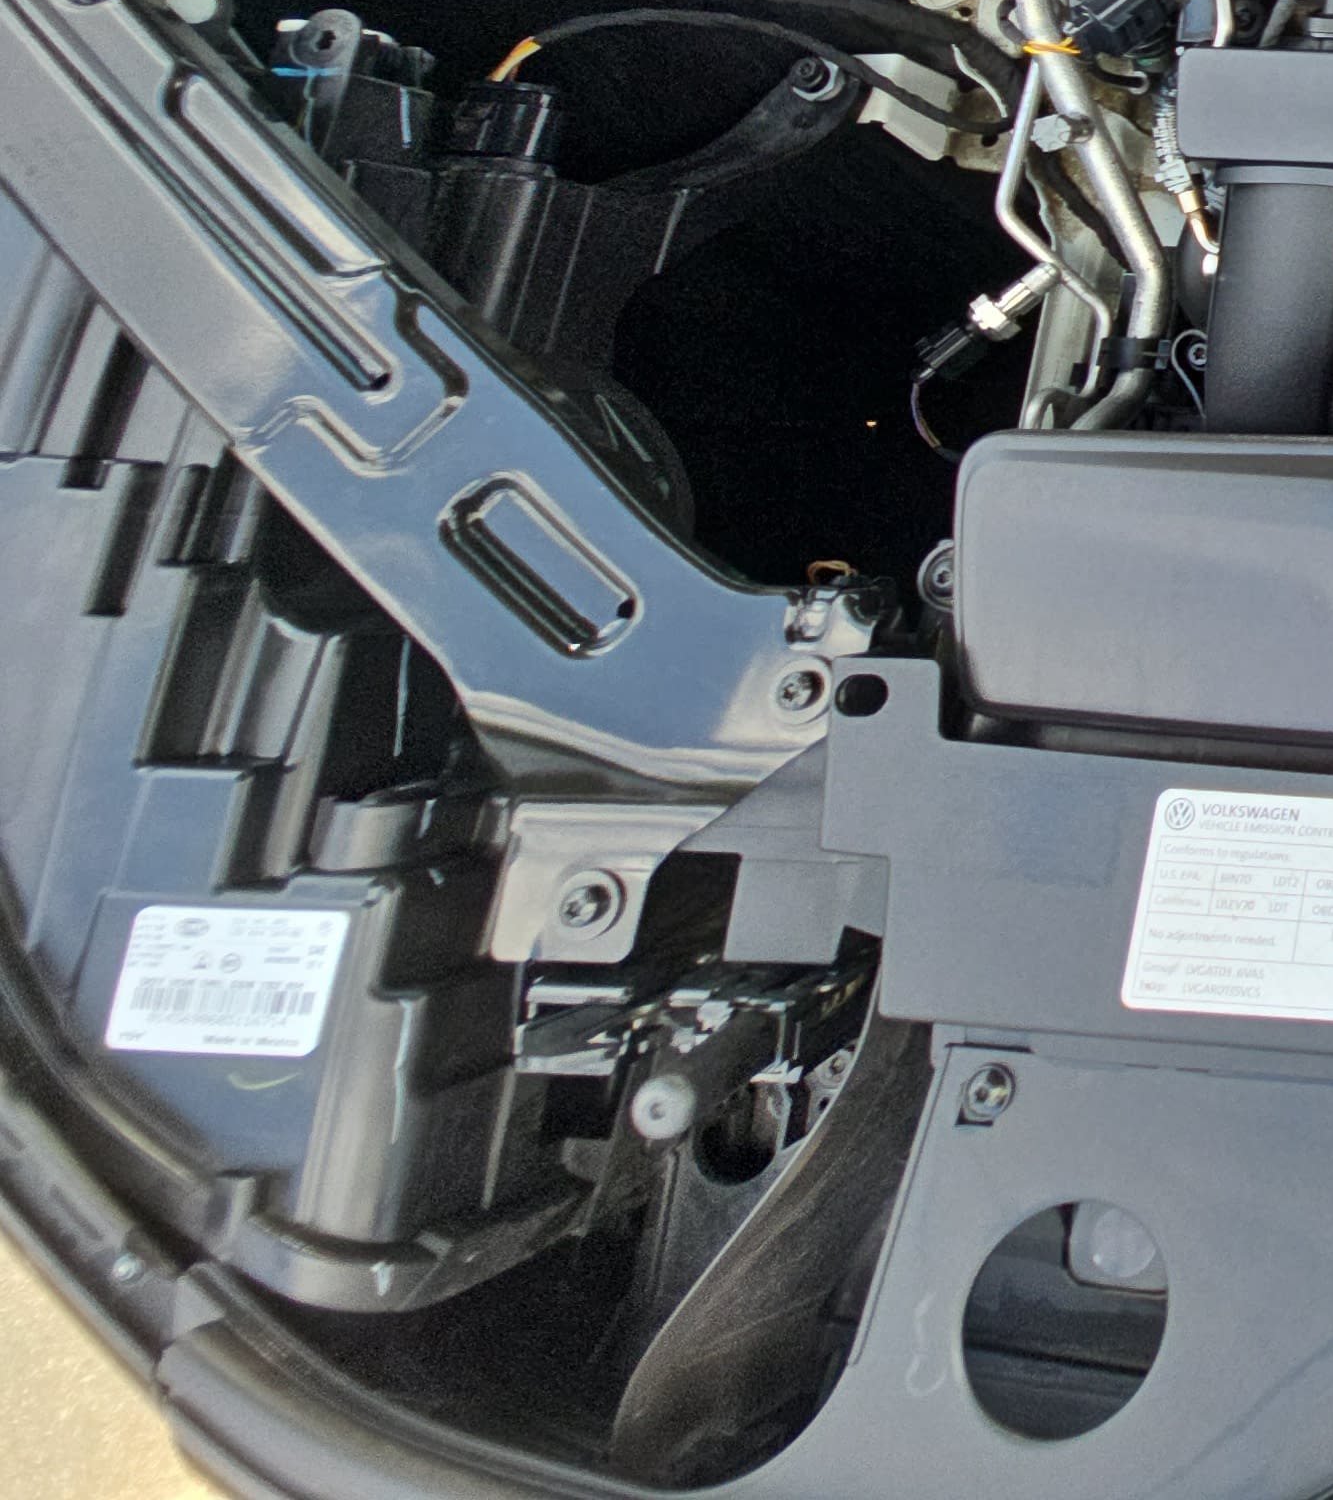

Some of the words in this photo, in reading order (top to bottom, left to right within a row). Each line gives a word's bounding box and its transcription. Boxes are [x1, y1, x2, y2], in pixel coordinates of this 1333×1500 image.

[1201, 803, 1300, 822] VOLKSWAGEN
[1199, 820, 1241, 833] VEHICLE
[1244, 823, 1295, 836] EMISSION
[1163, 843, 1214, 856] Conforms
[1217, 846, 1229, 858] to
[1272, 875, 1300, 888] LDT2
[1149, 927, 1163, 939] No
